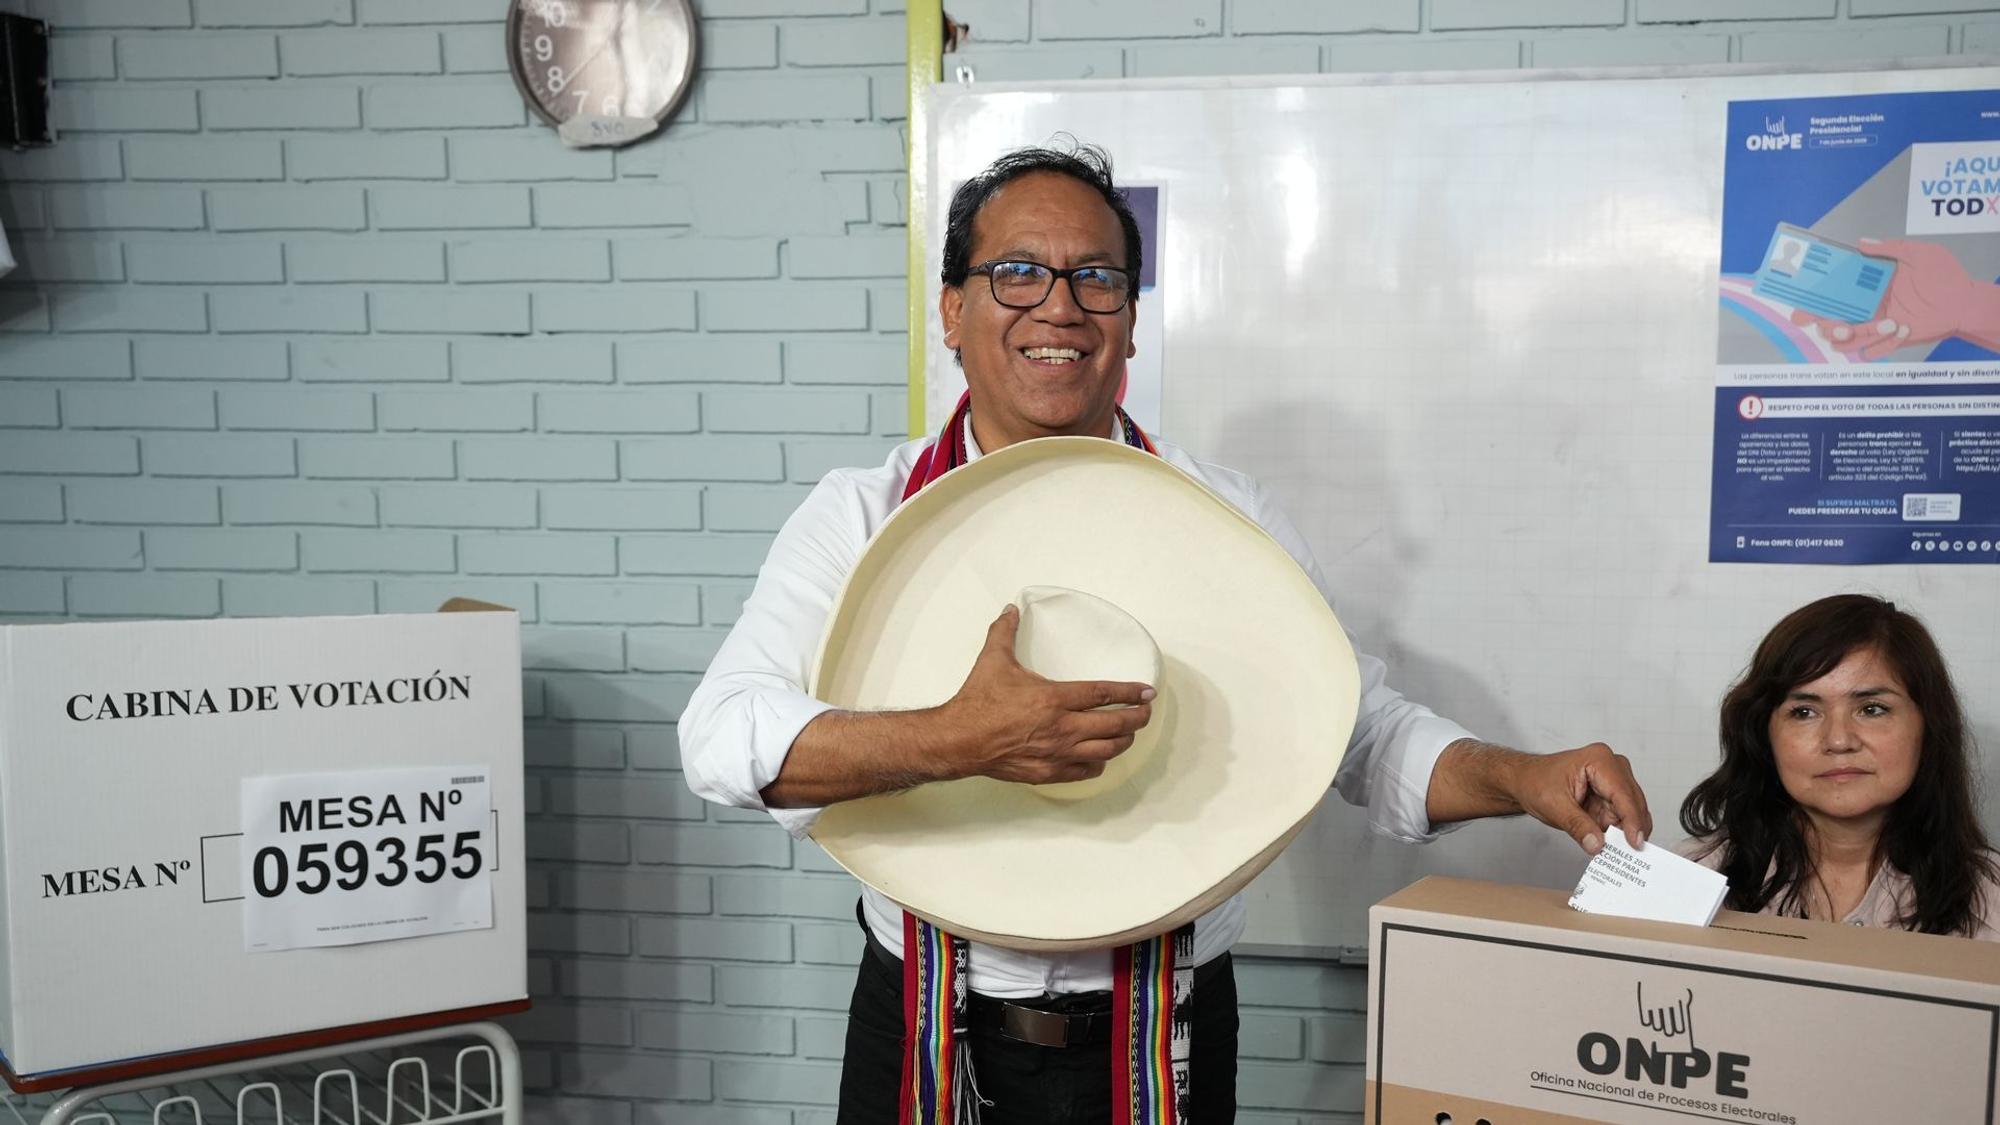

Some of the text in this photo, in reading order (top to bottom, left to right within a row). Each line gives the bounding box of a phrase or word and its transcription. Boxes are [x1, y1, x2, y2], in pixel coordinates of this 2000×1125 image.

[534, 35, 553, 61] 9
[547, 66, 564, 92] 8
[573, 90, 589, 114] 7
[1810, 116, 1847, 126] Segunda
[1810, 125, 1862, 135] Presidencial
[1746, 133, 1802, 151] ONPE
[1931, 195, 1999, 216] TODX
[1908, 369, 1948, 379] igualdad
[1957, 369, 1970, 377] sin
[1831, 403, 1854, 411] VOTO
[1912, 402, 1956, 410] PERSONAS
[1872, 507, 1898, 515] QUEJA
[66, 669, 471, 722] CABINA DE VOTACIÓN
[280, 789, 462, 833] MESA Nº
[253, 830, 482, 898] 059355
[1594, 857, 1647, 887] CEPRESIDENTES
[1622, 862, 1640, 875] PARA
[42, 859, 191, 898] MESA Nº
[1577, 1032, 1750, 1099] ONPE
[1530, 1071, 1796, 1125] Oficina Nacional de Procesos Electorales
